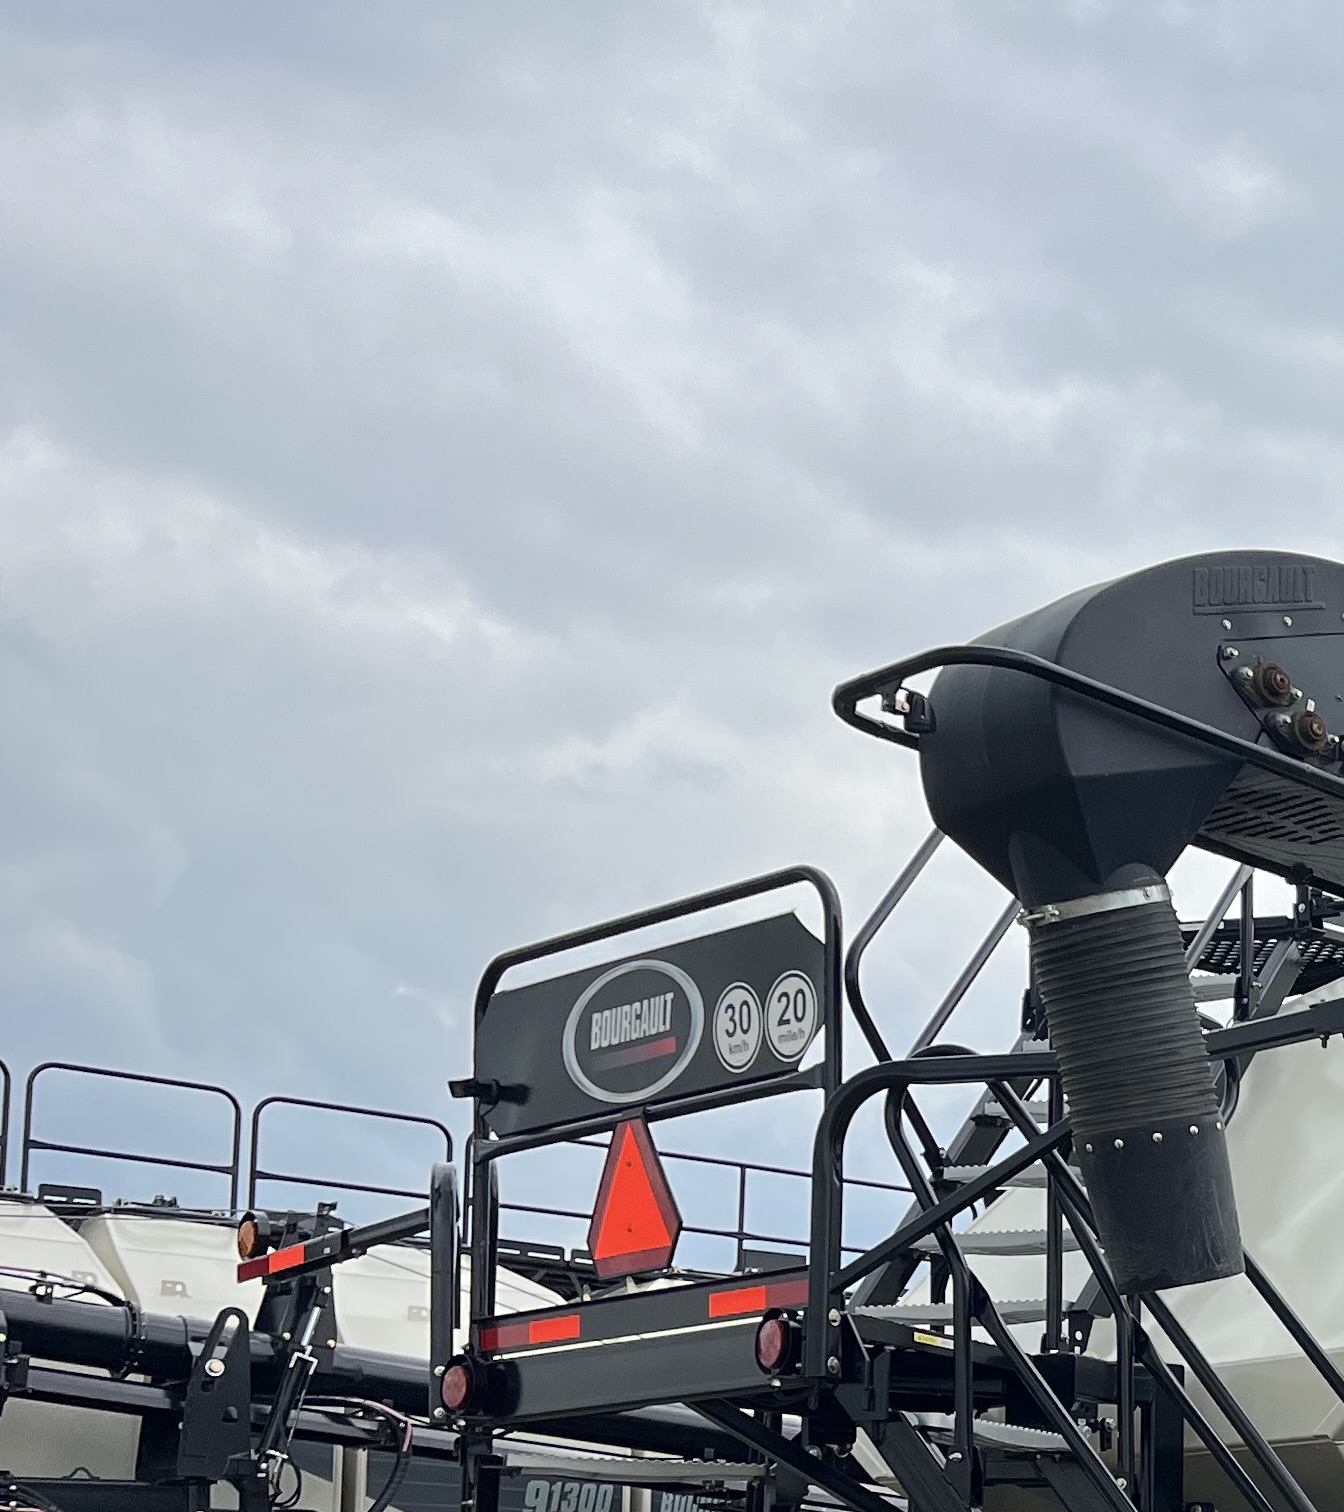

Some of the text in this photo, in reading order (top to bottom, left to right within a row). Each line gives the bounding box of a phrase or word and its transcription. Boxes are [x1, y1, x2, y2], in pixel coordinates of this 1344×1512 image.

[1192, 564, 1317, 607] BOURGAULT
[590, 992, 676, 1051] BOURGAULT
[724, 1000, 751, 1038] 30
[776, 988, 807, 1027] 20
[728, 1041, 750, 1055] km/h
[777, 1027, 806, 1045] mile/h
